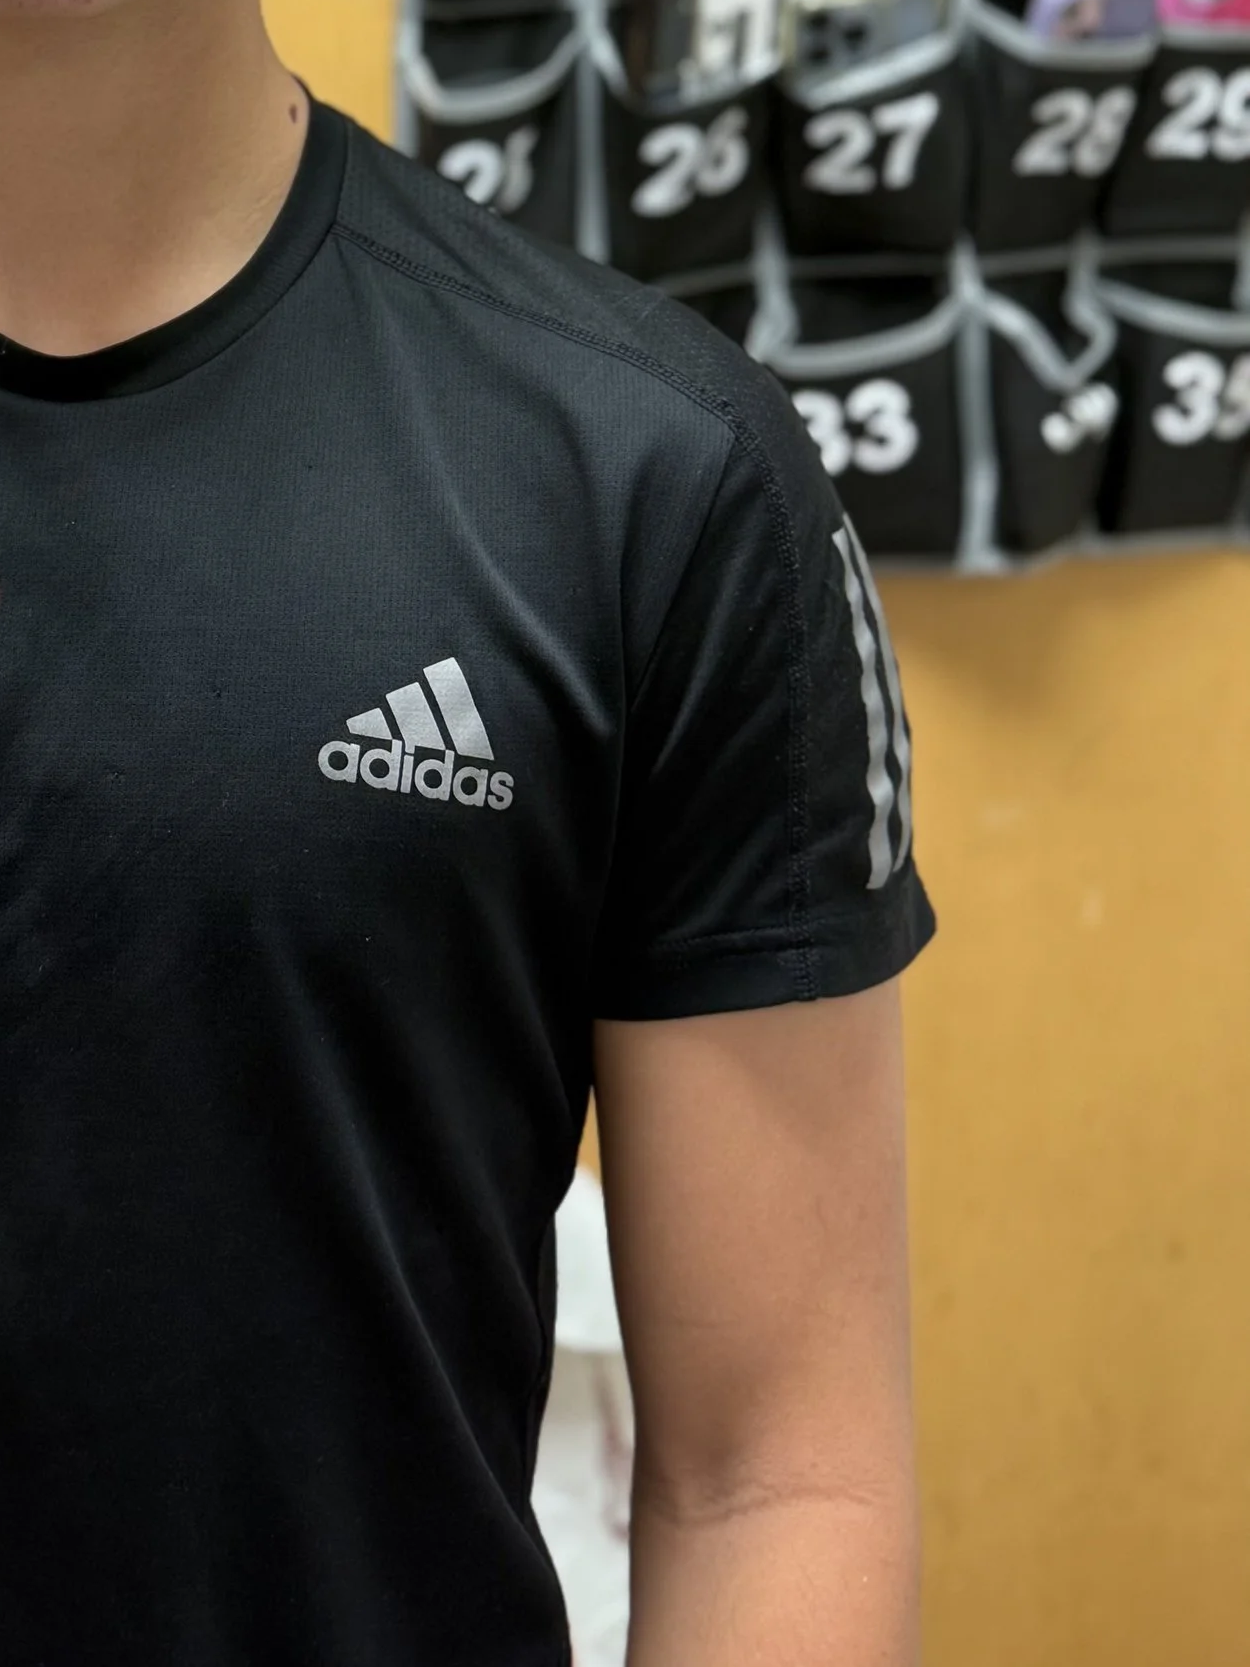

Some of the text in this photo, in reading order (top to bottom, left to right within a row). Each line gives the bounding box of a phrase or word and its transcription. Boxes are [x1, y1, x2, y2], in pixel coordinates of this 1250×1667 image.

[631, 106, 749, 217] 26
[799, 92, 940, 194] 27
[1013, 85, 1137, 178] 28
[790, 377, 920, 477] 33
[317, 738, 515, 811] adidas
